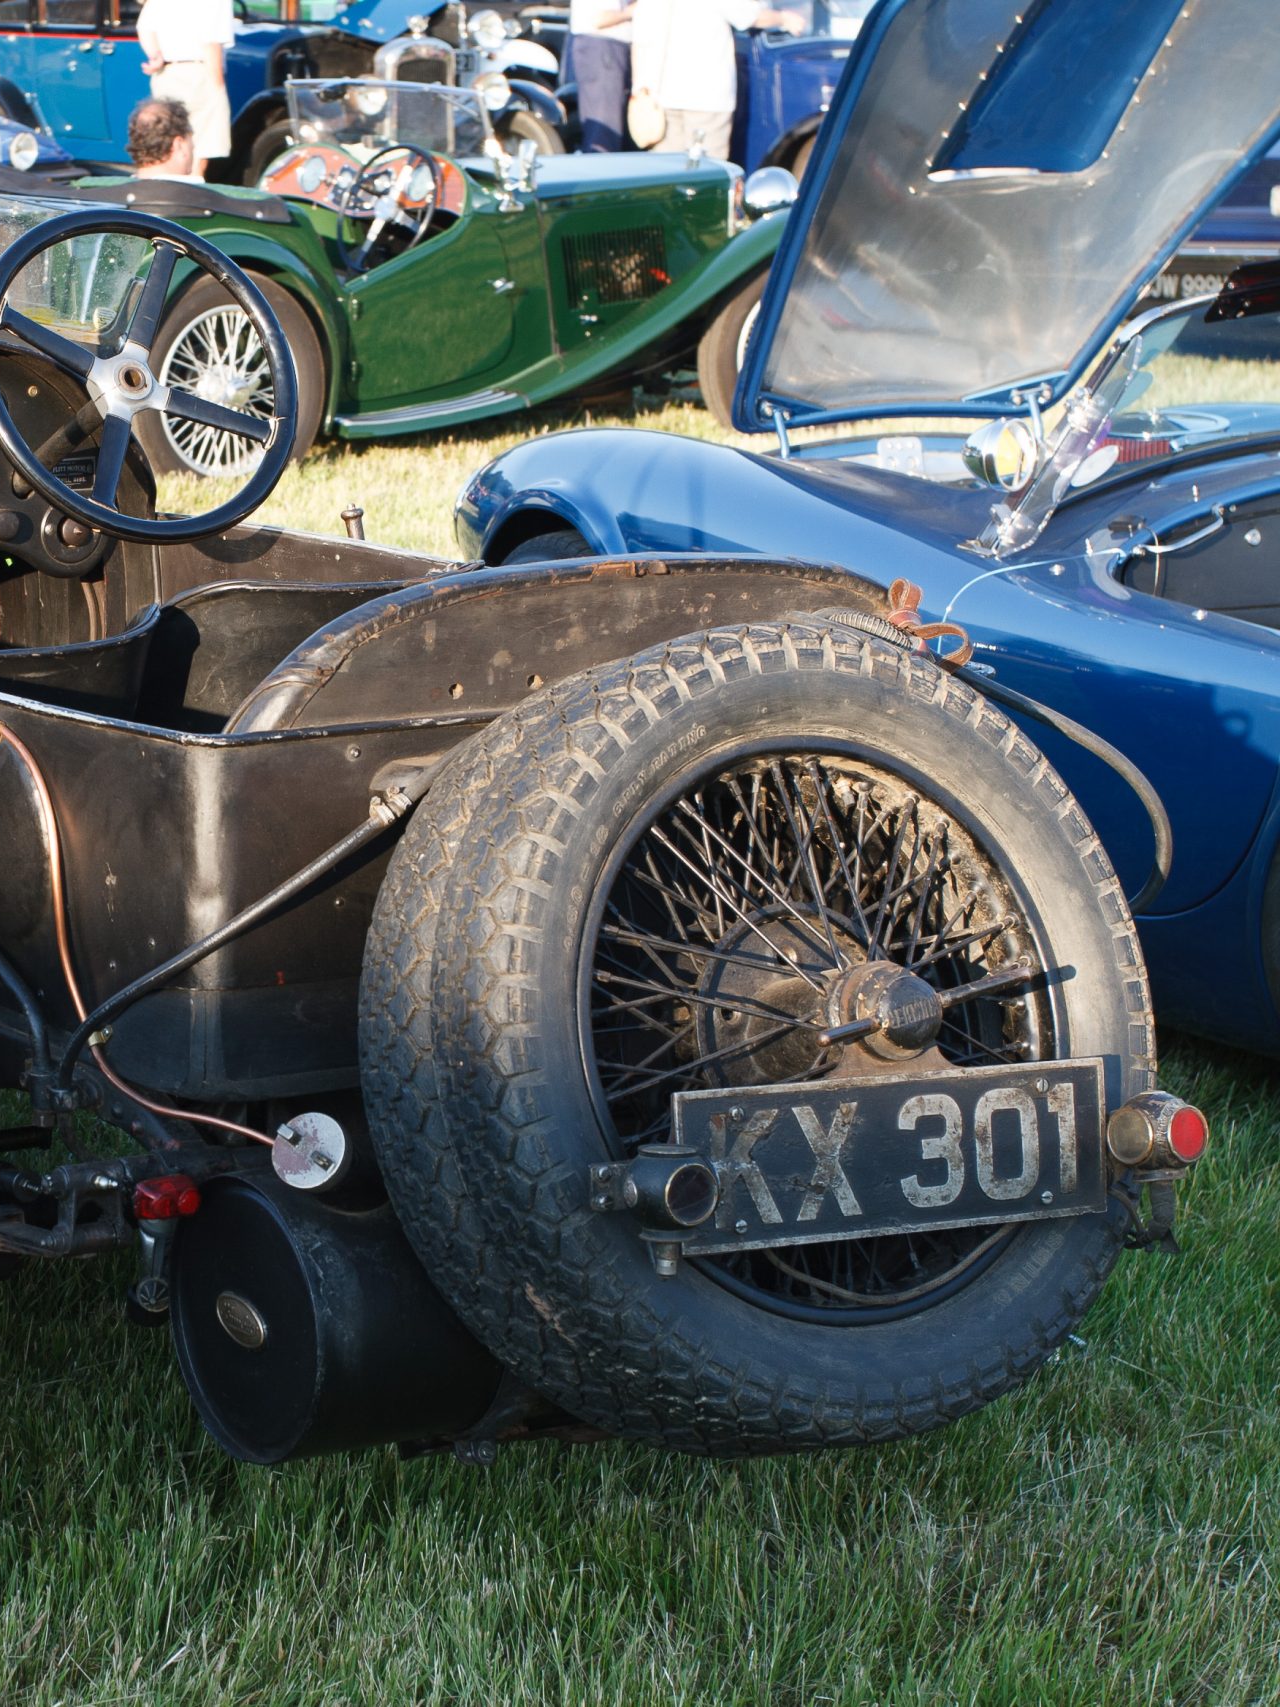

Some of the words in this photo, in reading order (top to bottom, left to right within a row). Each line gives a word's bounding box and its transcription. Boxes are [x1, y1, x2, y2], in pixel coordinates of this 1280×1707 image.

[651, 722, 707, 771] RATING
[709, 1101, 864, 1230] KX
[897, 1082, 1078, 1208] 301
